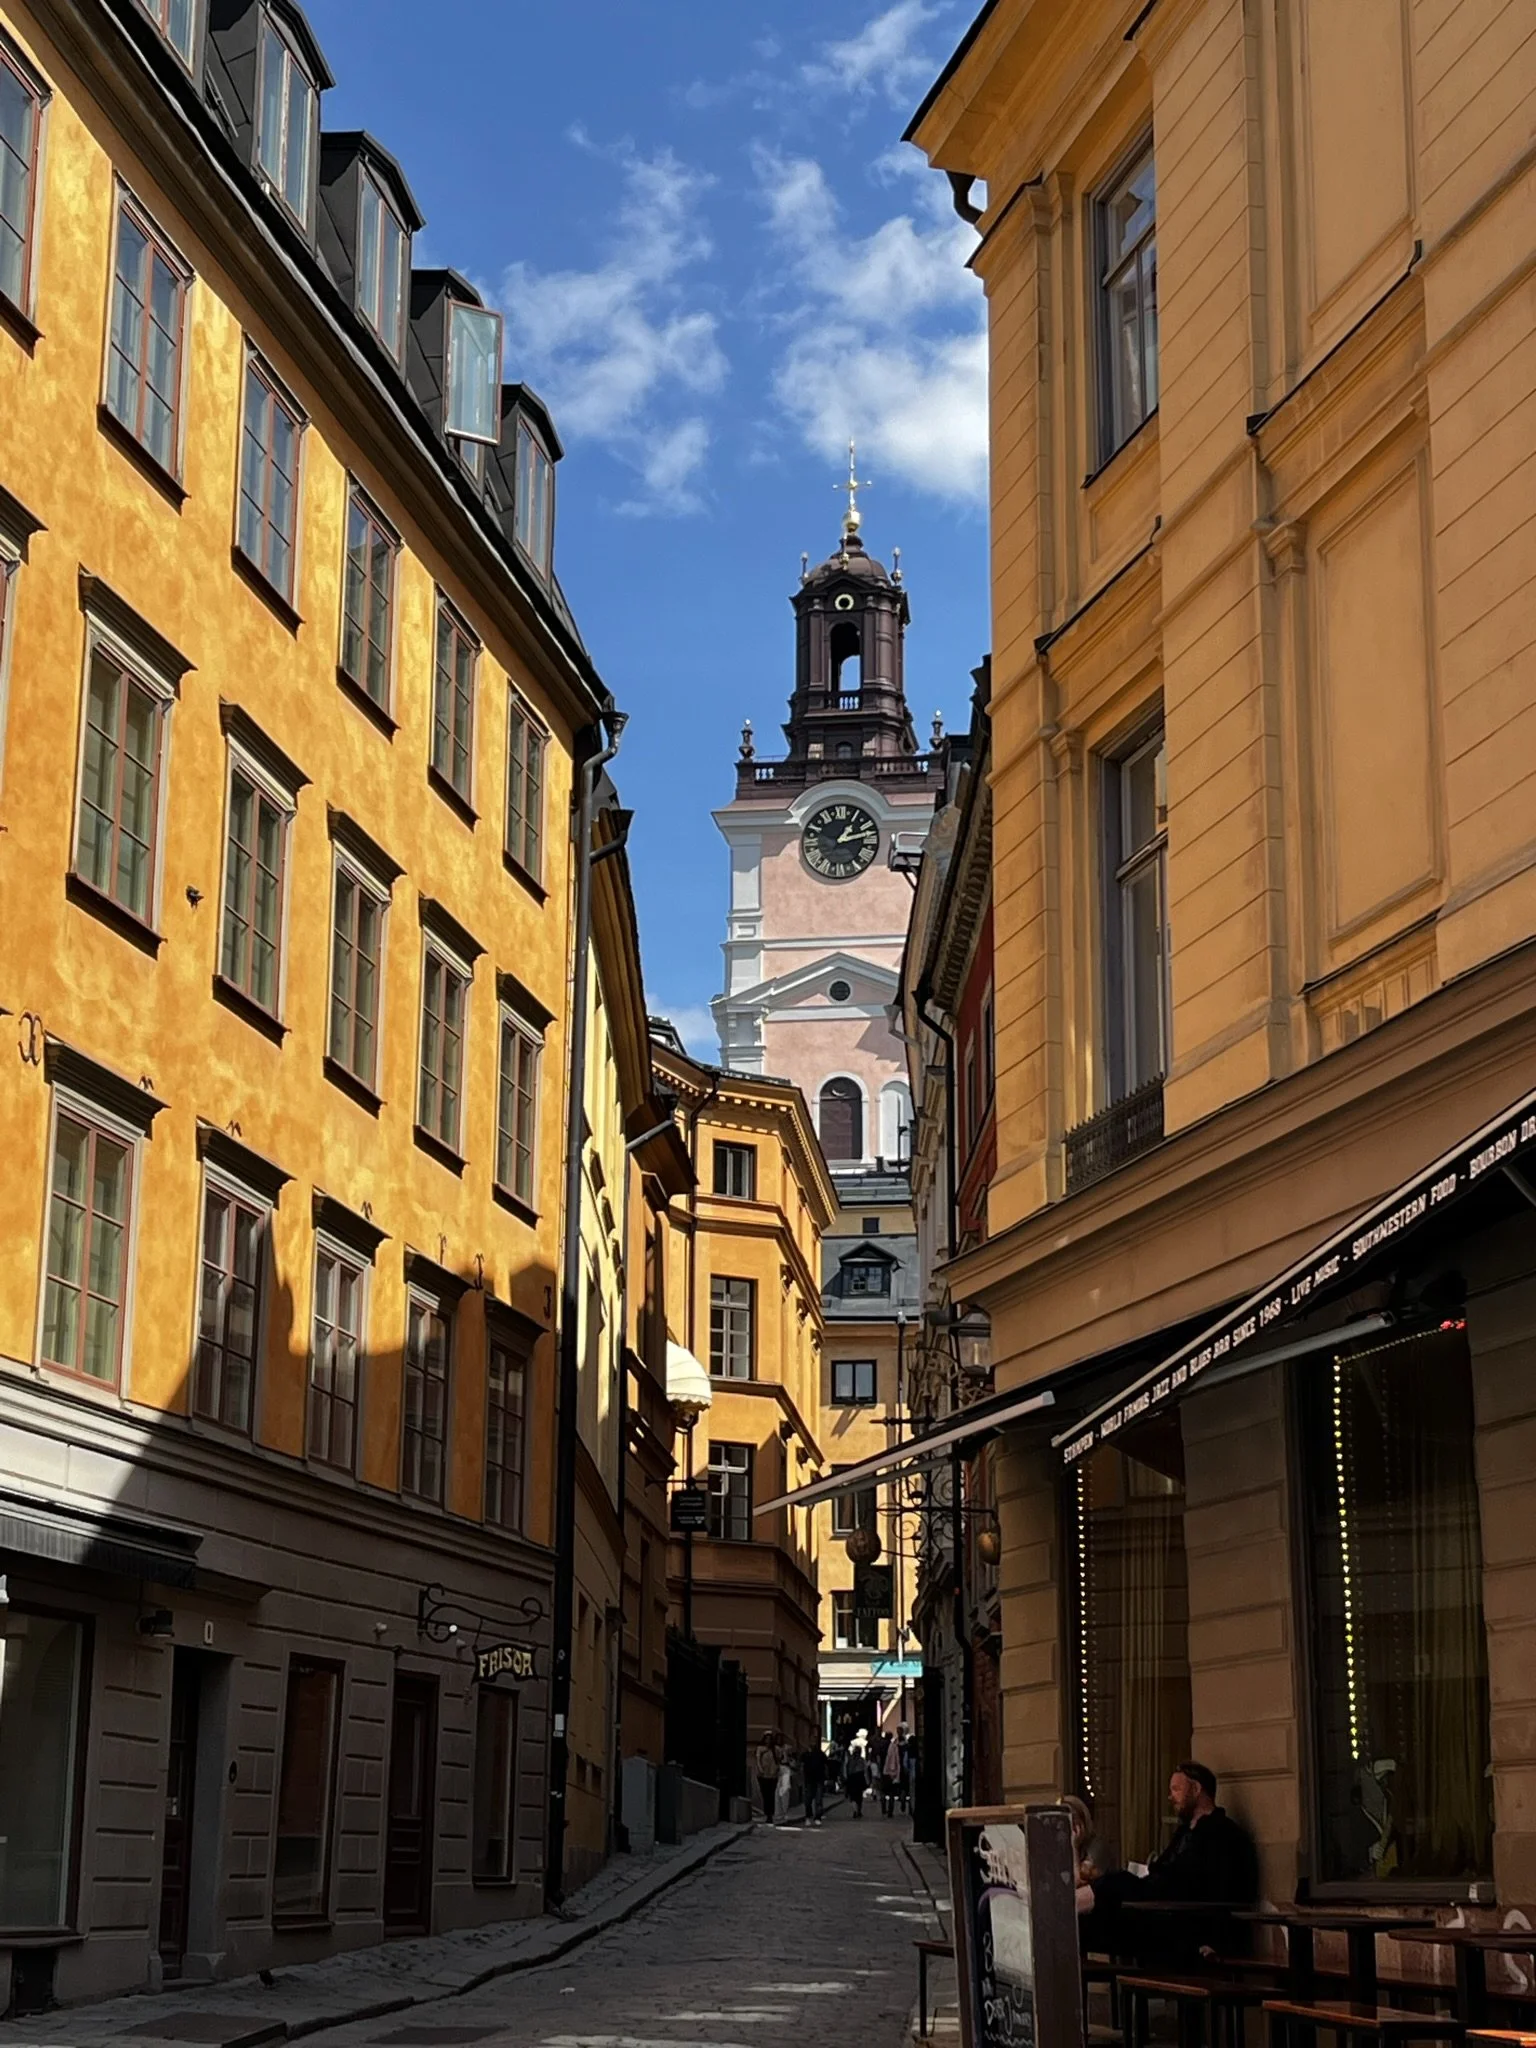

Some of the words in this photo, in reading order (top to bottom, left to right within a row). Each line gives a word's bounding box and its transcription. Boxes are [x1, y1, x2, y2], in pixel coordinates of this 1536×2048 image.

[1064, 1430, 1093, 1464] STAMPEN
[1124, 1391, 1150, 1423] FAMOUS
[1152, 1377, 1170, 1403] JAZZ
[1171, 1365, 1187, 1389] AND
[1190, 1347, 1212, 1376] BLUES
[1213, 1334, 1230, 1359] BAR
[1233, 1316, 1256, 1347] SINCE
[1260, 1297, 1281, 1327] 1968
[1291, 1276, 1312, 1304] LIVE
[1313, 1255, 1340, 1287] MUSIC
[1353, 1193, 1426, 1260] SOUTHWESTERN
[1430, 1173, 1456, 1205] FOOD
[1469, 1129, 1517, 1179] BOURBON
